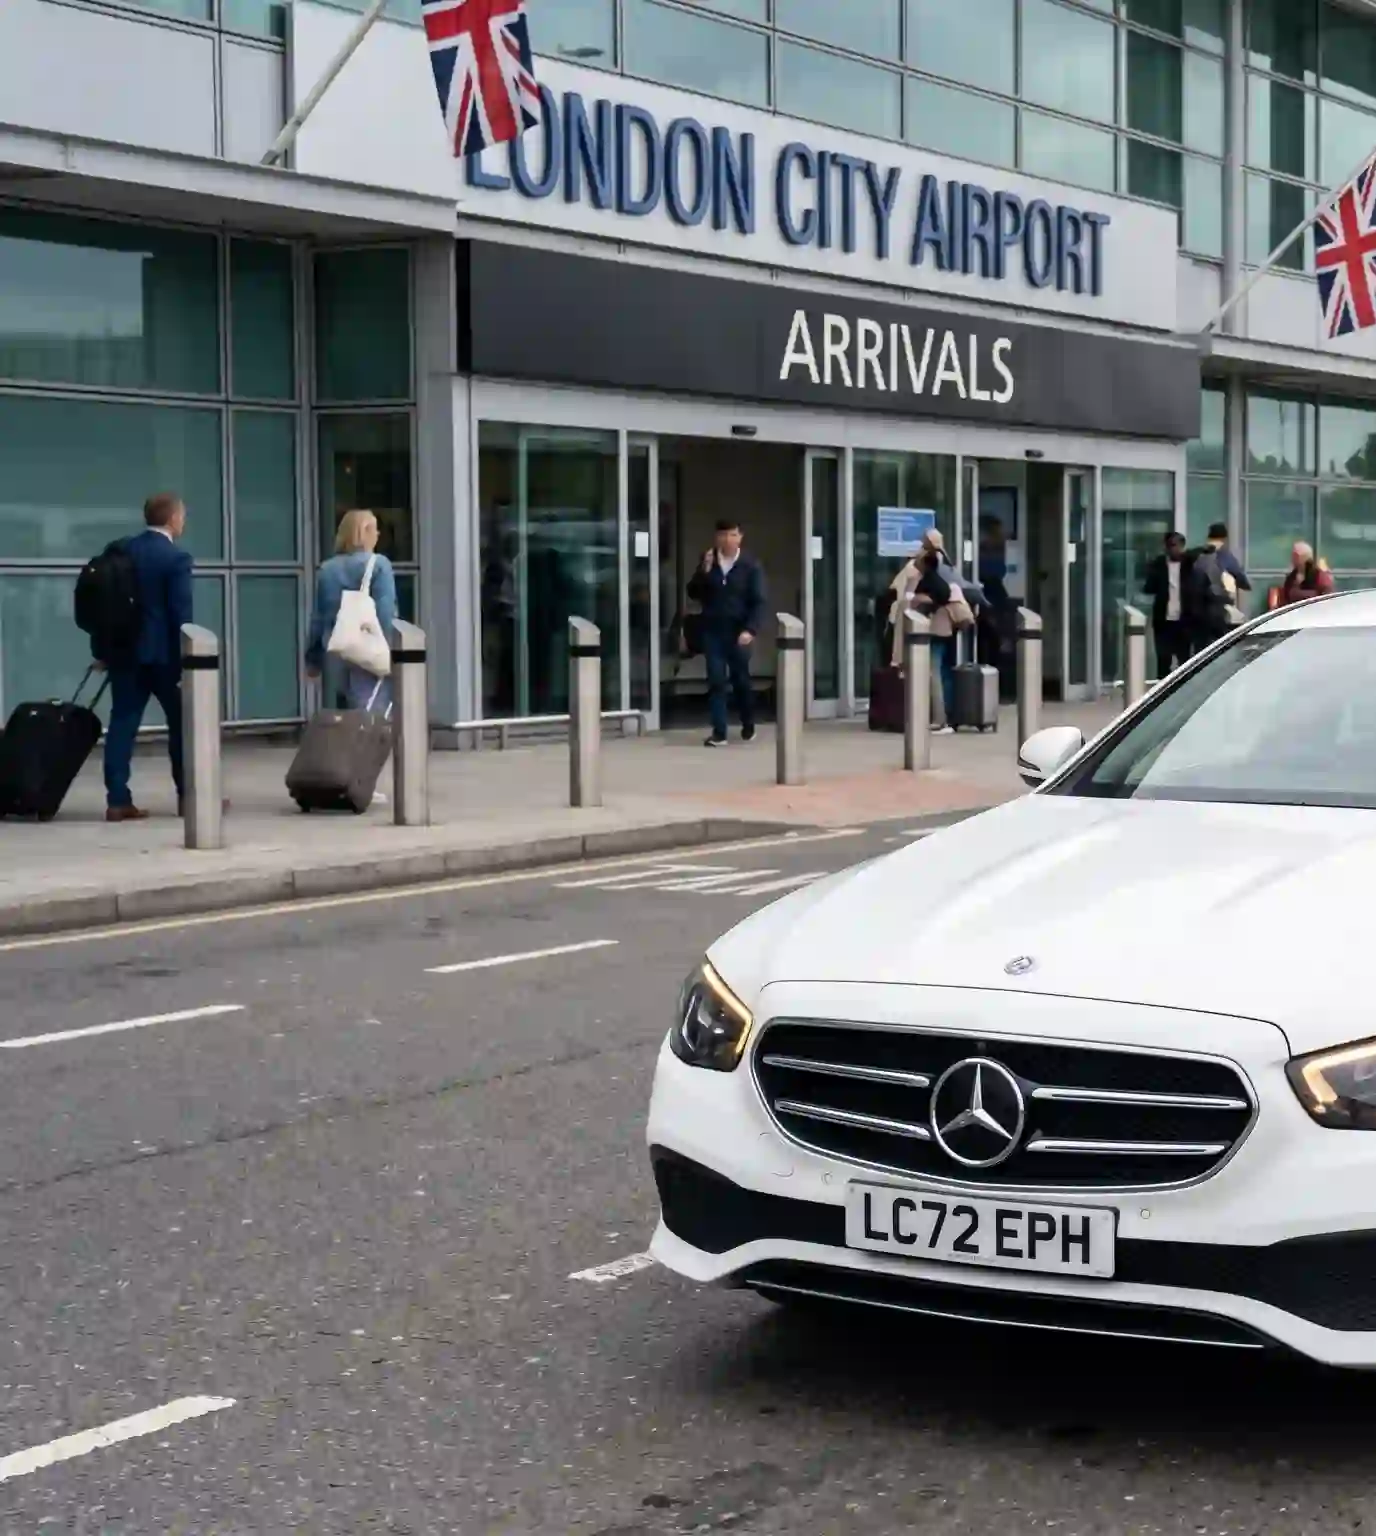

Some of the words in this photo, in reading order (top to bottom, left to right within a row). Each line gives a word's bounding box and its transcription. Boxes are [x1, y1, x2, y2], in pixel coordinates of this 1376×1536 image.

[774, 142, 901, 259] CITY
[909, 174, 1110, 297] AIRPORT
[780, 309, 1014, 404] ARRIVALS
[864, 1192, 980, 1254] LC72
[995, 1208, 1091, 1265] EPH
